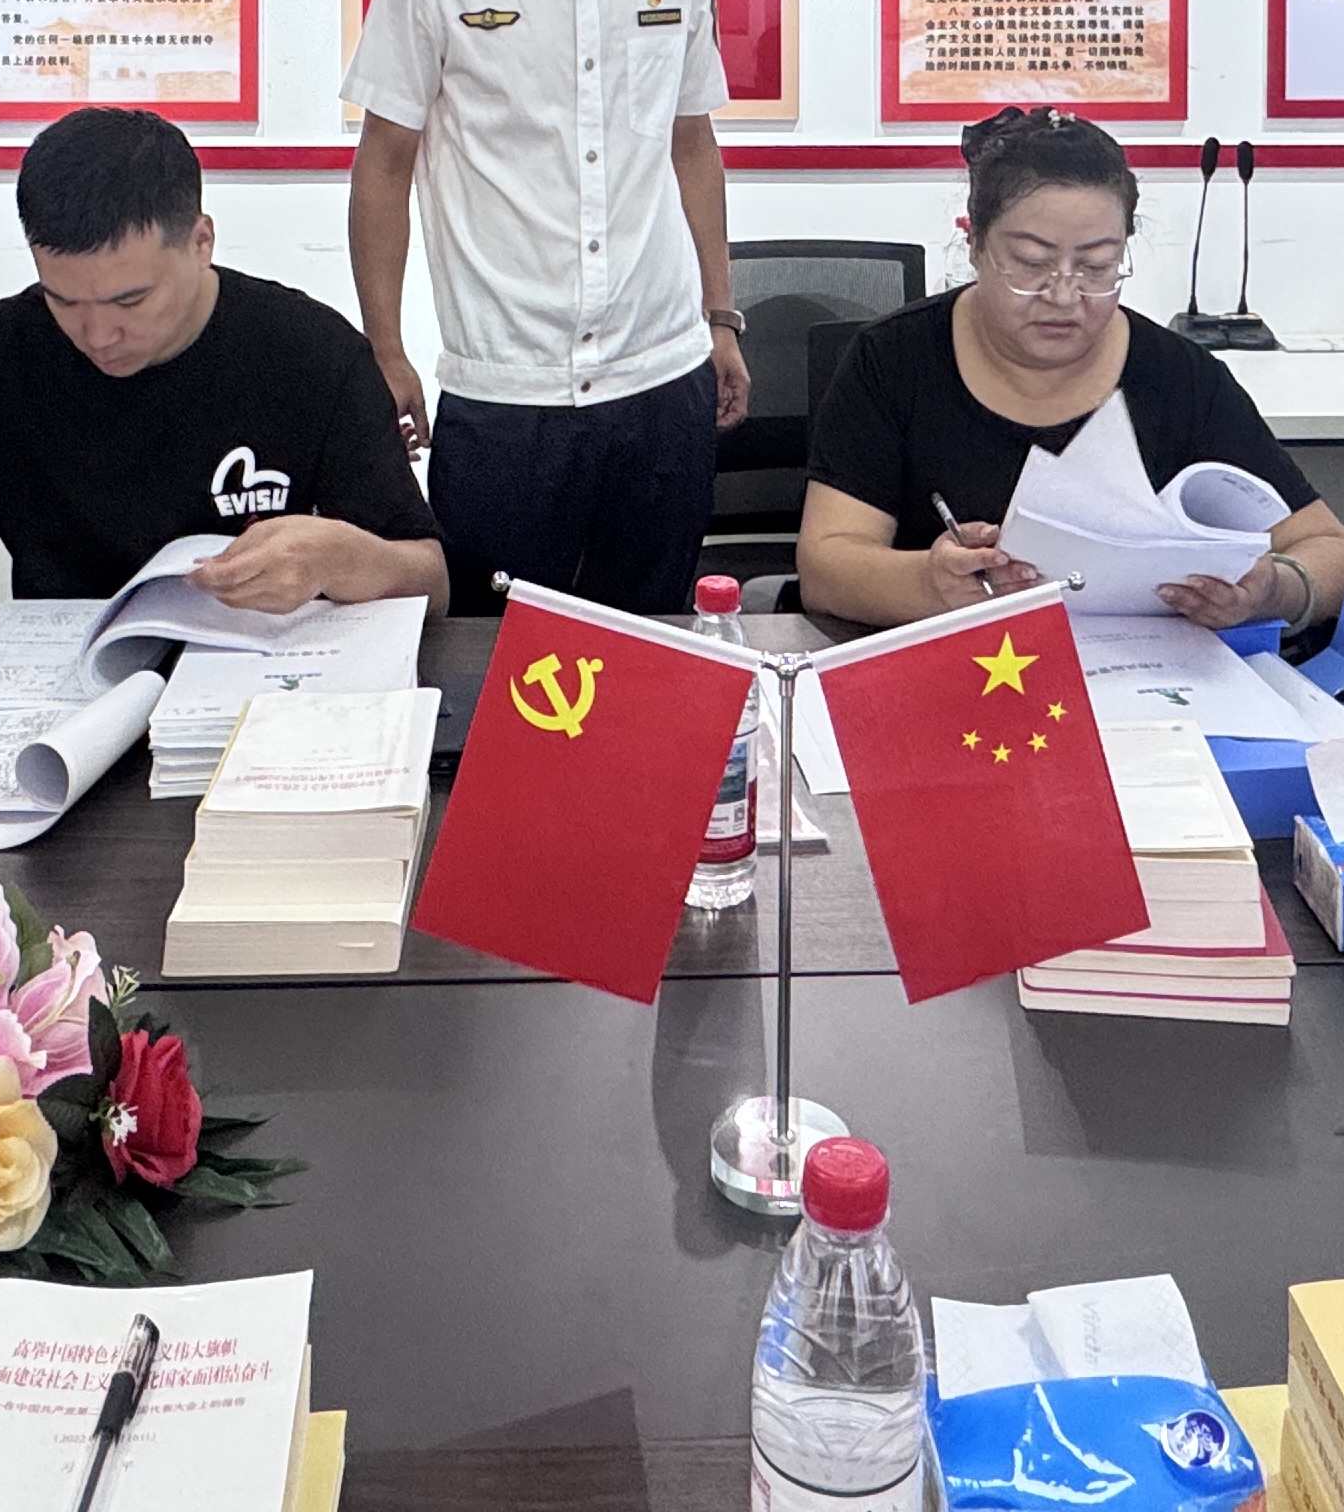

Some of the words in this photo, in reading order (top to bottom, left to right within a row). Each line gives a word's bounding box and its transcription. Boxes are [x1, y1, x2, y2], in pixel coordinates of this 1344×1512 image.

[214, 487, 290, 517] EVISU
[12, 1338, 237, 1364] 高举中国特色义伟大旗帜
